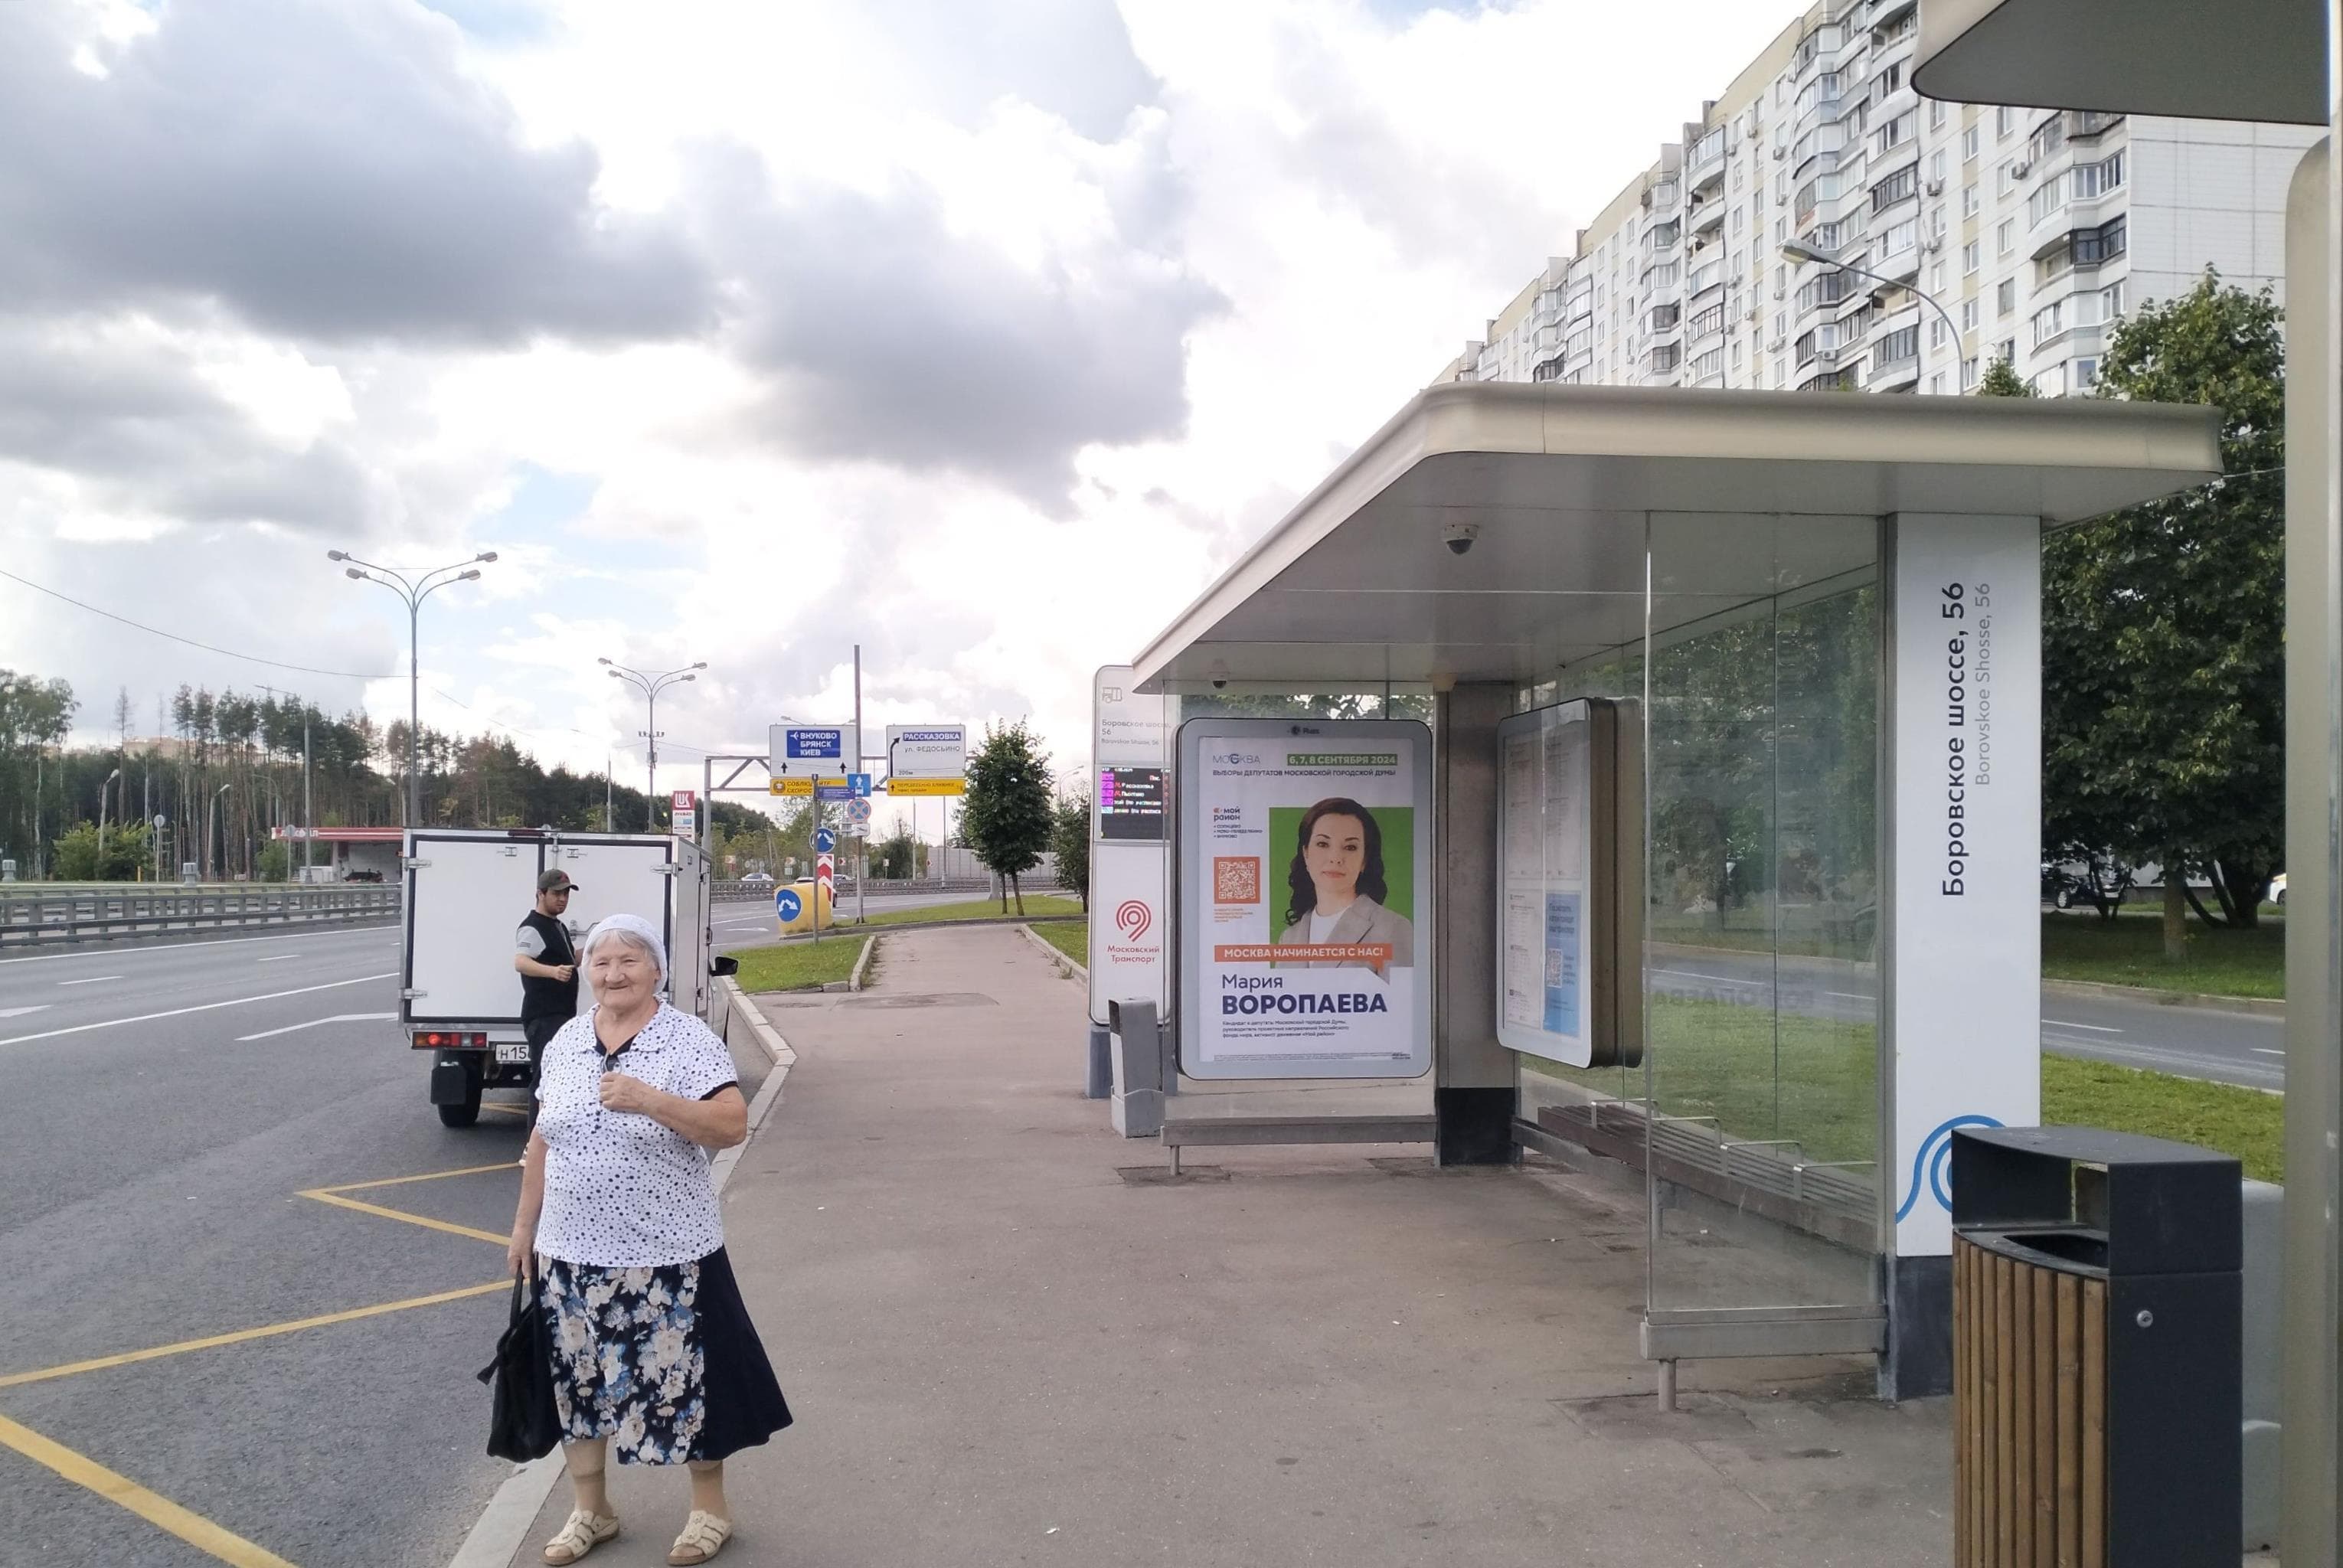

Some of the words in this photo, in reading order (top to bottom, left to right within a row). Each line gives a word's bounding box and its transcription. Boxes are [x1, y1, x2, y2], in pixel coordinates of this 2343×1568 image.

[1942, 581, 1965, 620] 56
[1975, 583, 1991, 607] 56
[1975, 615, 1992, 683] Shosse,
[1948, 629, 1969, 727] шоссе,
[1102, 719, 1144, 727] Боровское
[1975, 688, 1991, 786] Borovskoe
[1212, 753, 1261, 765] МОСКВА
[1309, 756, 1315, 764] 8
[1317, 756, 1369, 764] СЕНТЯБРЯ
[1371, 755, 1396, 764] 2024
[1375, 769, 1396, 777] ДУМЫ
[1942, 737, 1969, 897] Боровское
[1111, 955, 1155, 965] Транспорт
[1224, 948, 1272, 959] МОСКВА
[1273, 947, 1346, 957] НАЧИНАЕТСЯ
[1348, 947, 1355, 956] С
[1357, 947, 1384, 956] НАС!
[1222, 974, 1283, 993] Мария
[1222, 993, 1387, 1015] ВОРОПАЕВА
[500, 1047, 528, 1060] Н15
